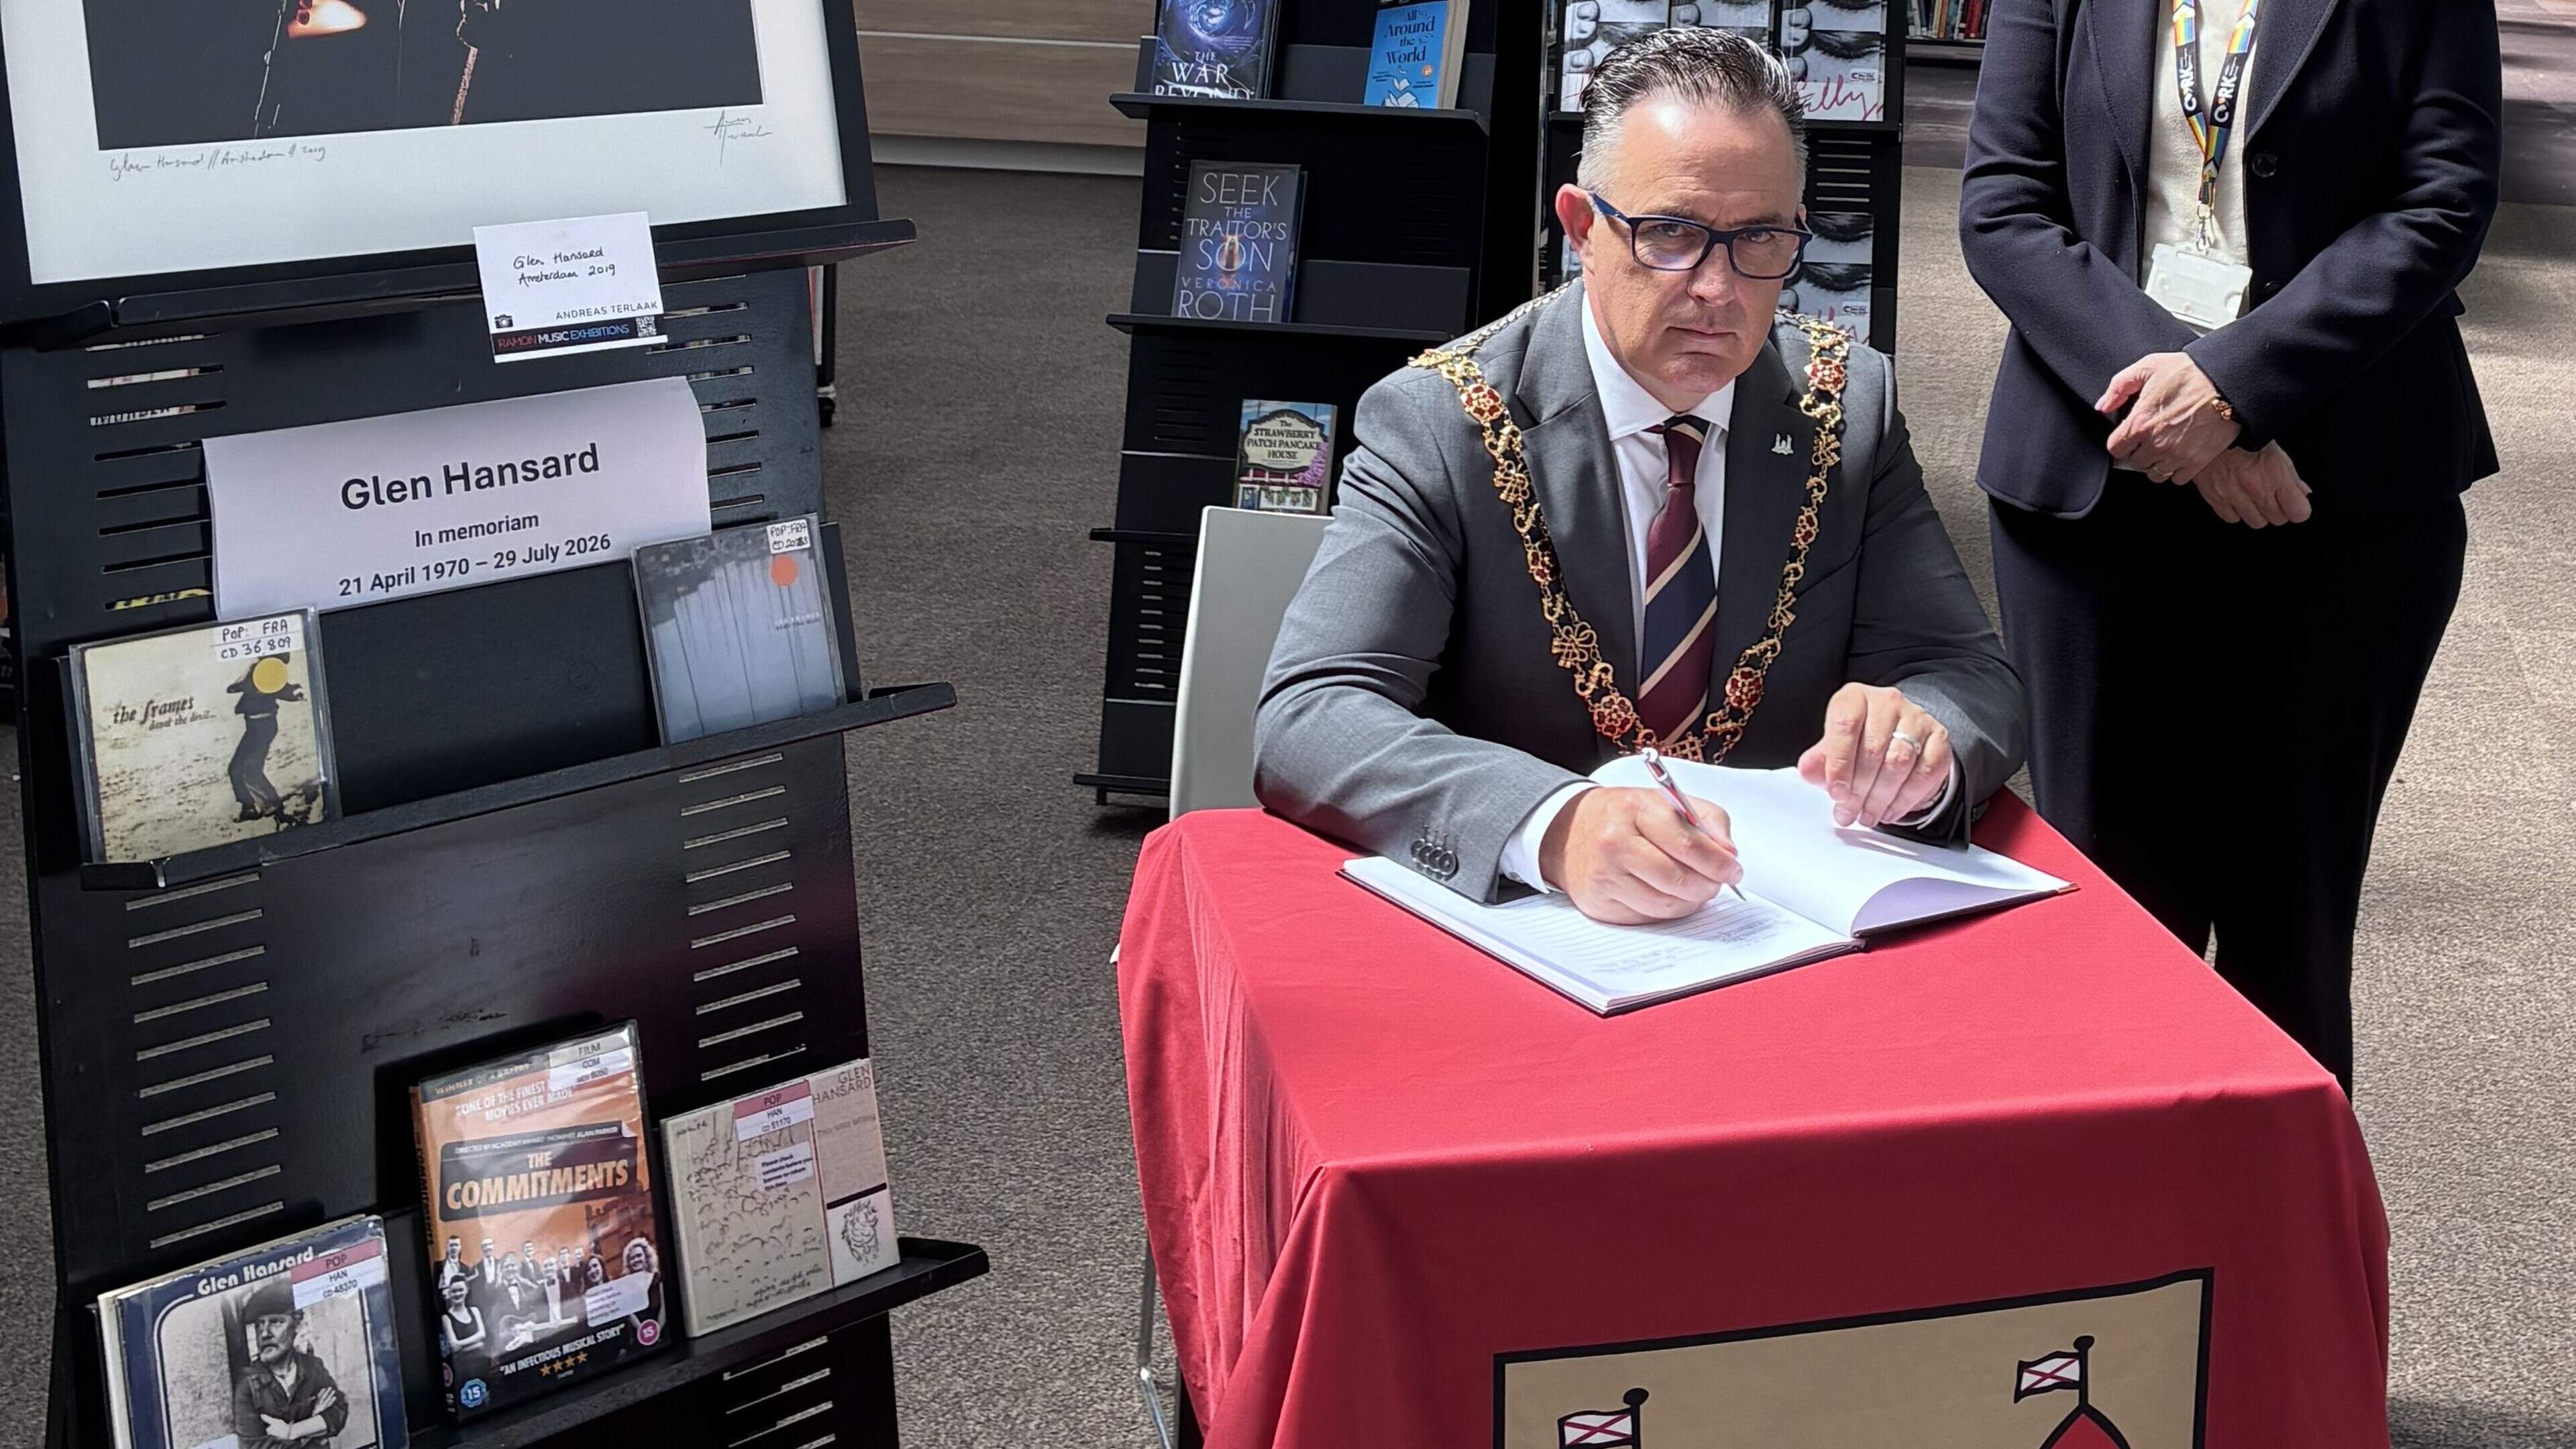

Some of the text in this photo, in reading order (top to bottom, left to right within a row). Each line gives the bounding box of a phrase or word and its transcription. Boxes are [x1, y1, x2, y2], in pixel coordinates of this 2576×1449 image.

[1389, 16, 1436, 37] Around
[1399, 36, 1415, 47] the
[1194, 51, 1217, 64] THE
[1387, 45, 1427, 64] World
[1172, 62, 1228, 83] WAR
[1200, 172, 1280, 207] SEEK
[1224, 206, 1252, 219] THE
[1187, 218, 1287, 241] TRAITOR'S
[513, 246, 604, 270] Glen Hansard
[1196, 238, 1273, 272] SON
[519, 263, 616, 288] Amsterdam 2019
[1181, 276, 1277, 292] VERONICA
[555, 301, 658, 320] ANDREAS TERLAAK
[1177, 290, 1275, 323] ROTH
[497, 323, 630, 349] RAMON MUSIC EXHIBITIONS
[1253, 428, 1317, 439] STRAWBERRY
[1246, 438, 1320, 451] PATCH PANCAKE
[1267, 449, 1299, 460] HOUSE
[340, 443, 601, 511] Glen Hansard
[414, 513, 539, 548] In memoriam
[338, 577, 365, 597] 21
[370, 566, 416, 595] April
[421, 557, 470, 582] 1970
[493, 549, 517, 570] 29
[521, 541, 560, 567] July
[565, 533, 612, 557] 2026
[262, 619, 288, 635] FRA
[221, 637, 292, 659] CD 36 809
[113, 696, 195, 725] the frames
[578, 1042, 601, 1056] FILM
[838, 1065, 871, 1085] GLEN
[483, 1095, 498, 1109] OF
[498, 1091, 515, 1105] THE
[515, 1080, 547, 1100] FINEST
[763, 1093, 782, 1107] POP
[813, 1076, 871, 1105] HANSARD
[485, 1104, 522, 1122] MOVIES
[522, 1095, 546, 1111] EVER
[767, 1108, 783, 1119] HAN
[527, 1150, 553, 1170] THE
[445, 1159, 629, 1210] COMMITMENTS
[197, 1246, 315, 1297] Glen Hansard
[325, 1253, 348, 1269] POP
[329, 1269, 349, 1283] HAN
[642, 1326, 655, 1338] 15
[517, 1346, 561, 1371] INFECTIOUS
[562, 1335, 596, 1355] MUSICAL
[467, 1385, 481, 1400] 15
